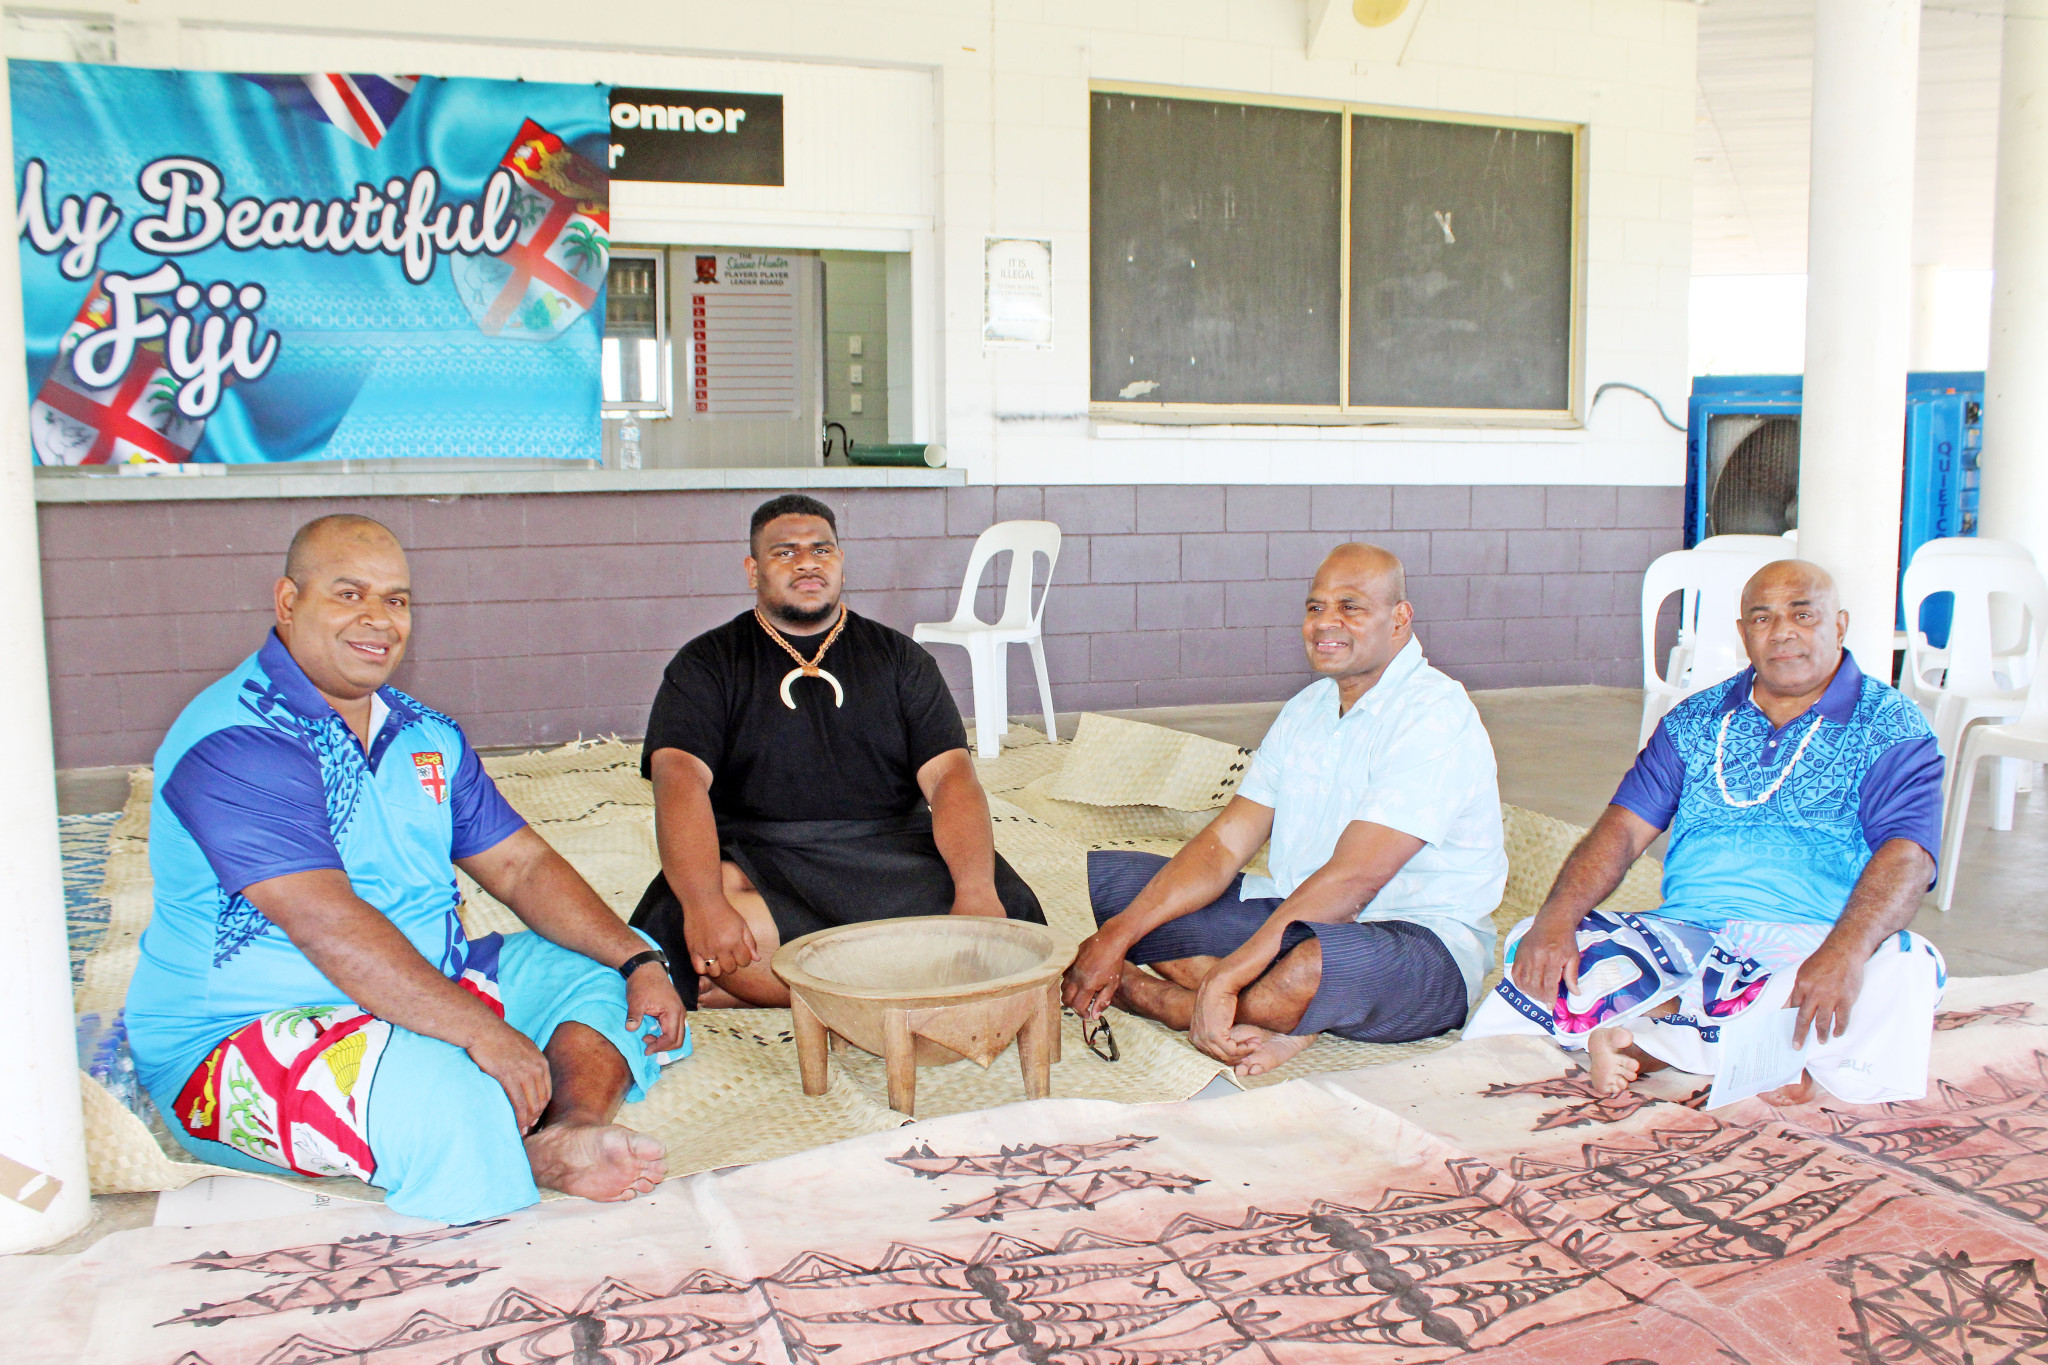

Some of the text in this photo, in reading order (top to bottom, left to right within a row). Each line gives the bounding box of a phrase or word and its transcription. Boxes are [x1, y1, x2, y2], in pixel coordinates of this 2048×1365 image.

[610, 102, 746, 133] onnor
[131, 155, 520, 284] Beautiful
[1000, 269, 1035, 279] ILLEGAL
[1008, 258, 1026, 268] IT IS
[73, 260, 281, 419] Fiji
[1838, 1058, 1873, 1074] BLK
